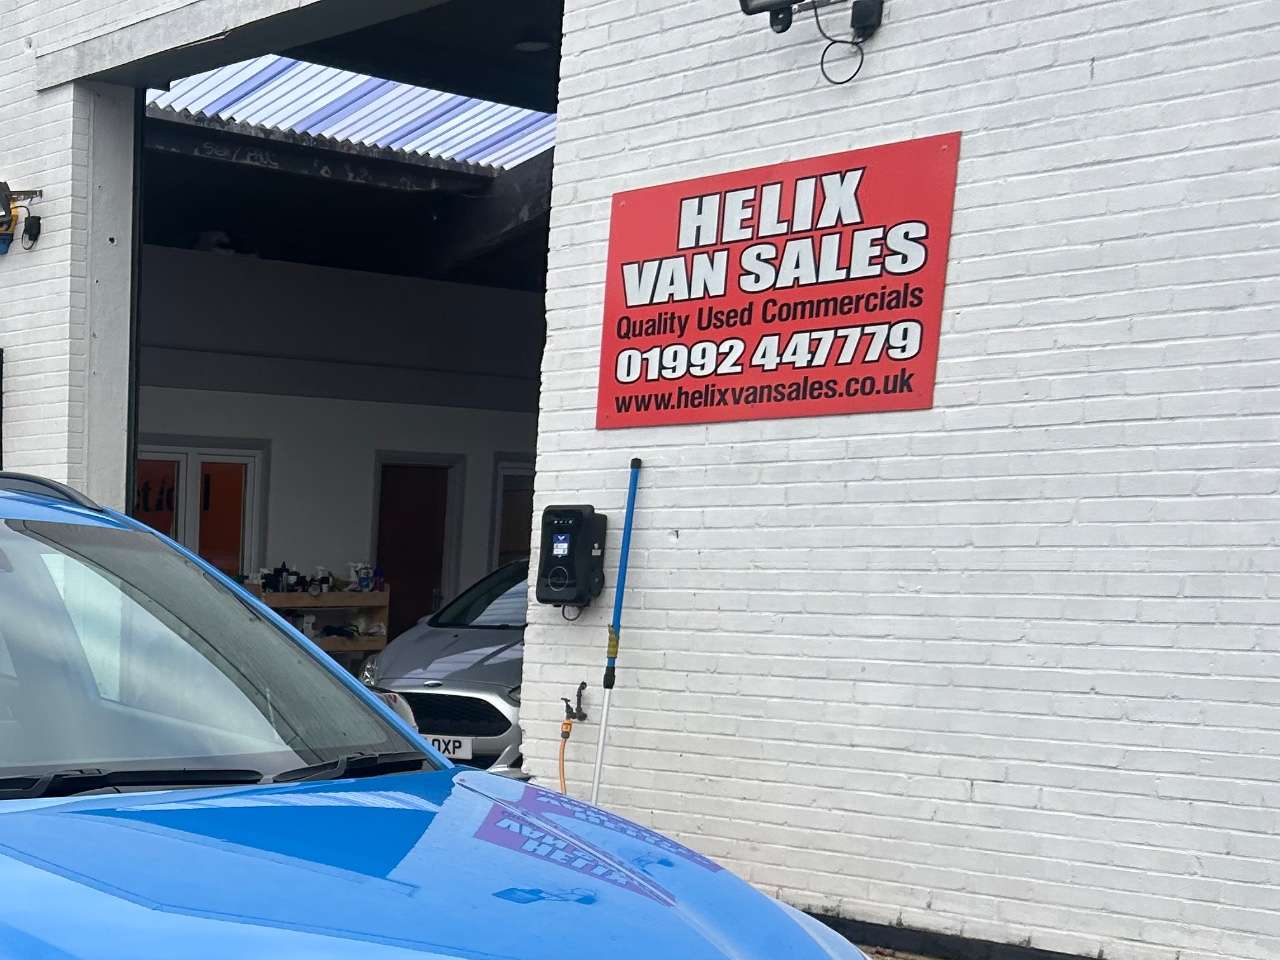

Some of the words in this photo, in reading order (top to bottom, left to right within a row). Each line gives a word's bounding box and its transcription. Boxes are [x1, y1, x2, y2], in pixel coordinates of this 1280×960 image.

[677, 166, 867, 251] HELIX
[621, 248, 729, 309] VAN
[738, 220, 929, 294] SALES
[617, 312, 690, 340] Quality
[697, 302, 753, 331] Used
[762, 283, 924, 324] Commercials
[615, 337, 747, 384] 01992
[749, 319, 924, 373] 447779
[615, 367, 915, 413] www.helixvansales.co.uk
